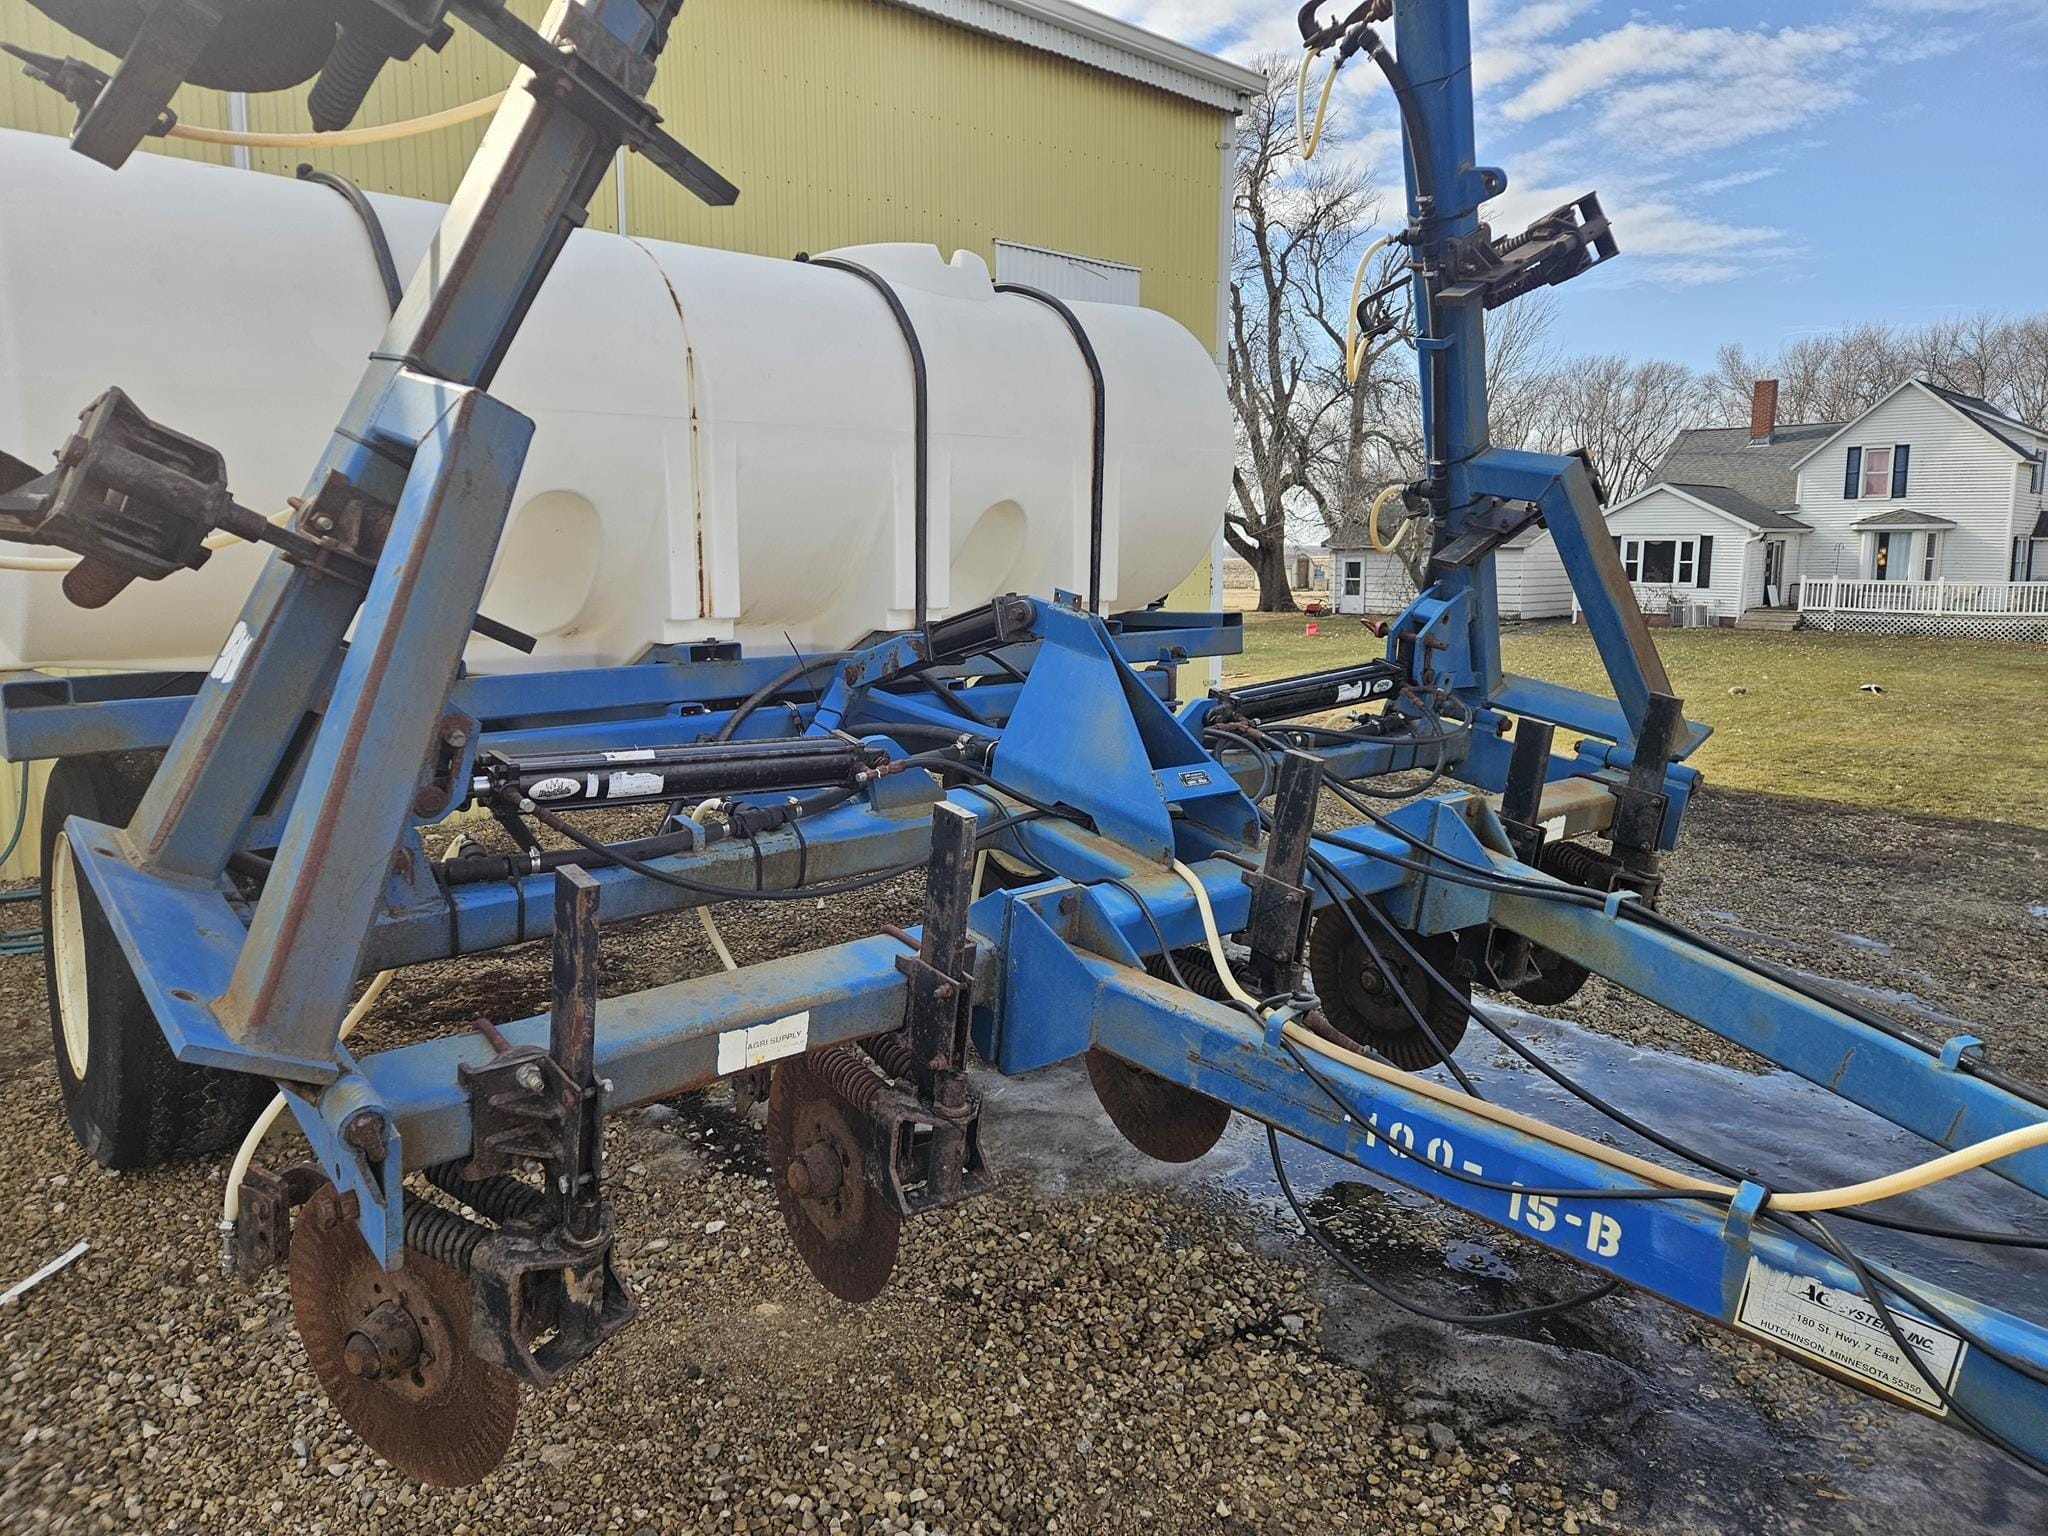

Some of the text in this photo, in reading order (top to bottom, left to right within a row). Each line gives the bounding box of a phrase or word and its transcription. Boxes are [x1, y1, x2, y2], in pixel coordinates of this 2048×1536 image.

[747, 1040, 768, 1050] AGRI
[770, 1030, 802, 1045] SUPPLY
[1835, 1330, 1861, 1348] Hwy.
[1865, 1343, 1872, 1351] 7
[1874, 1346, 1900, 1365] East
[1829, 1349, 1889, 1382] MINNESOTA
[1892, 1376, 1922, 1395] 55350
